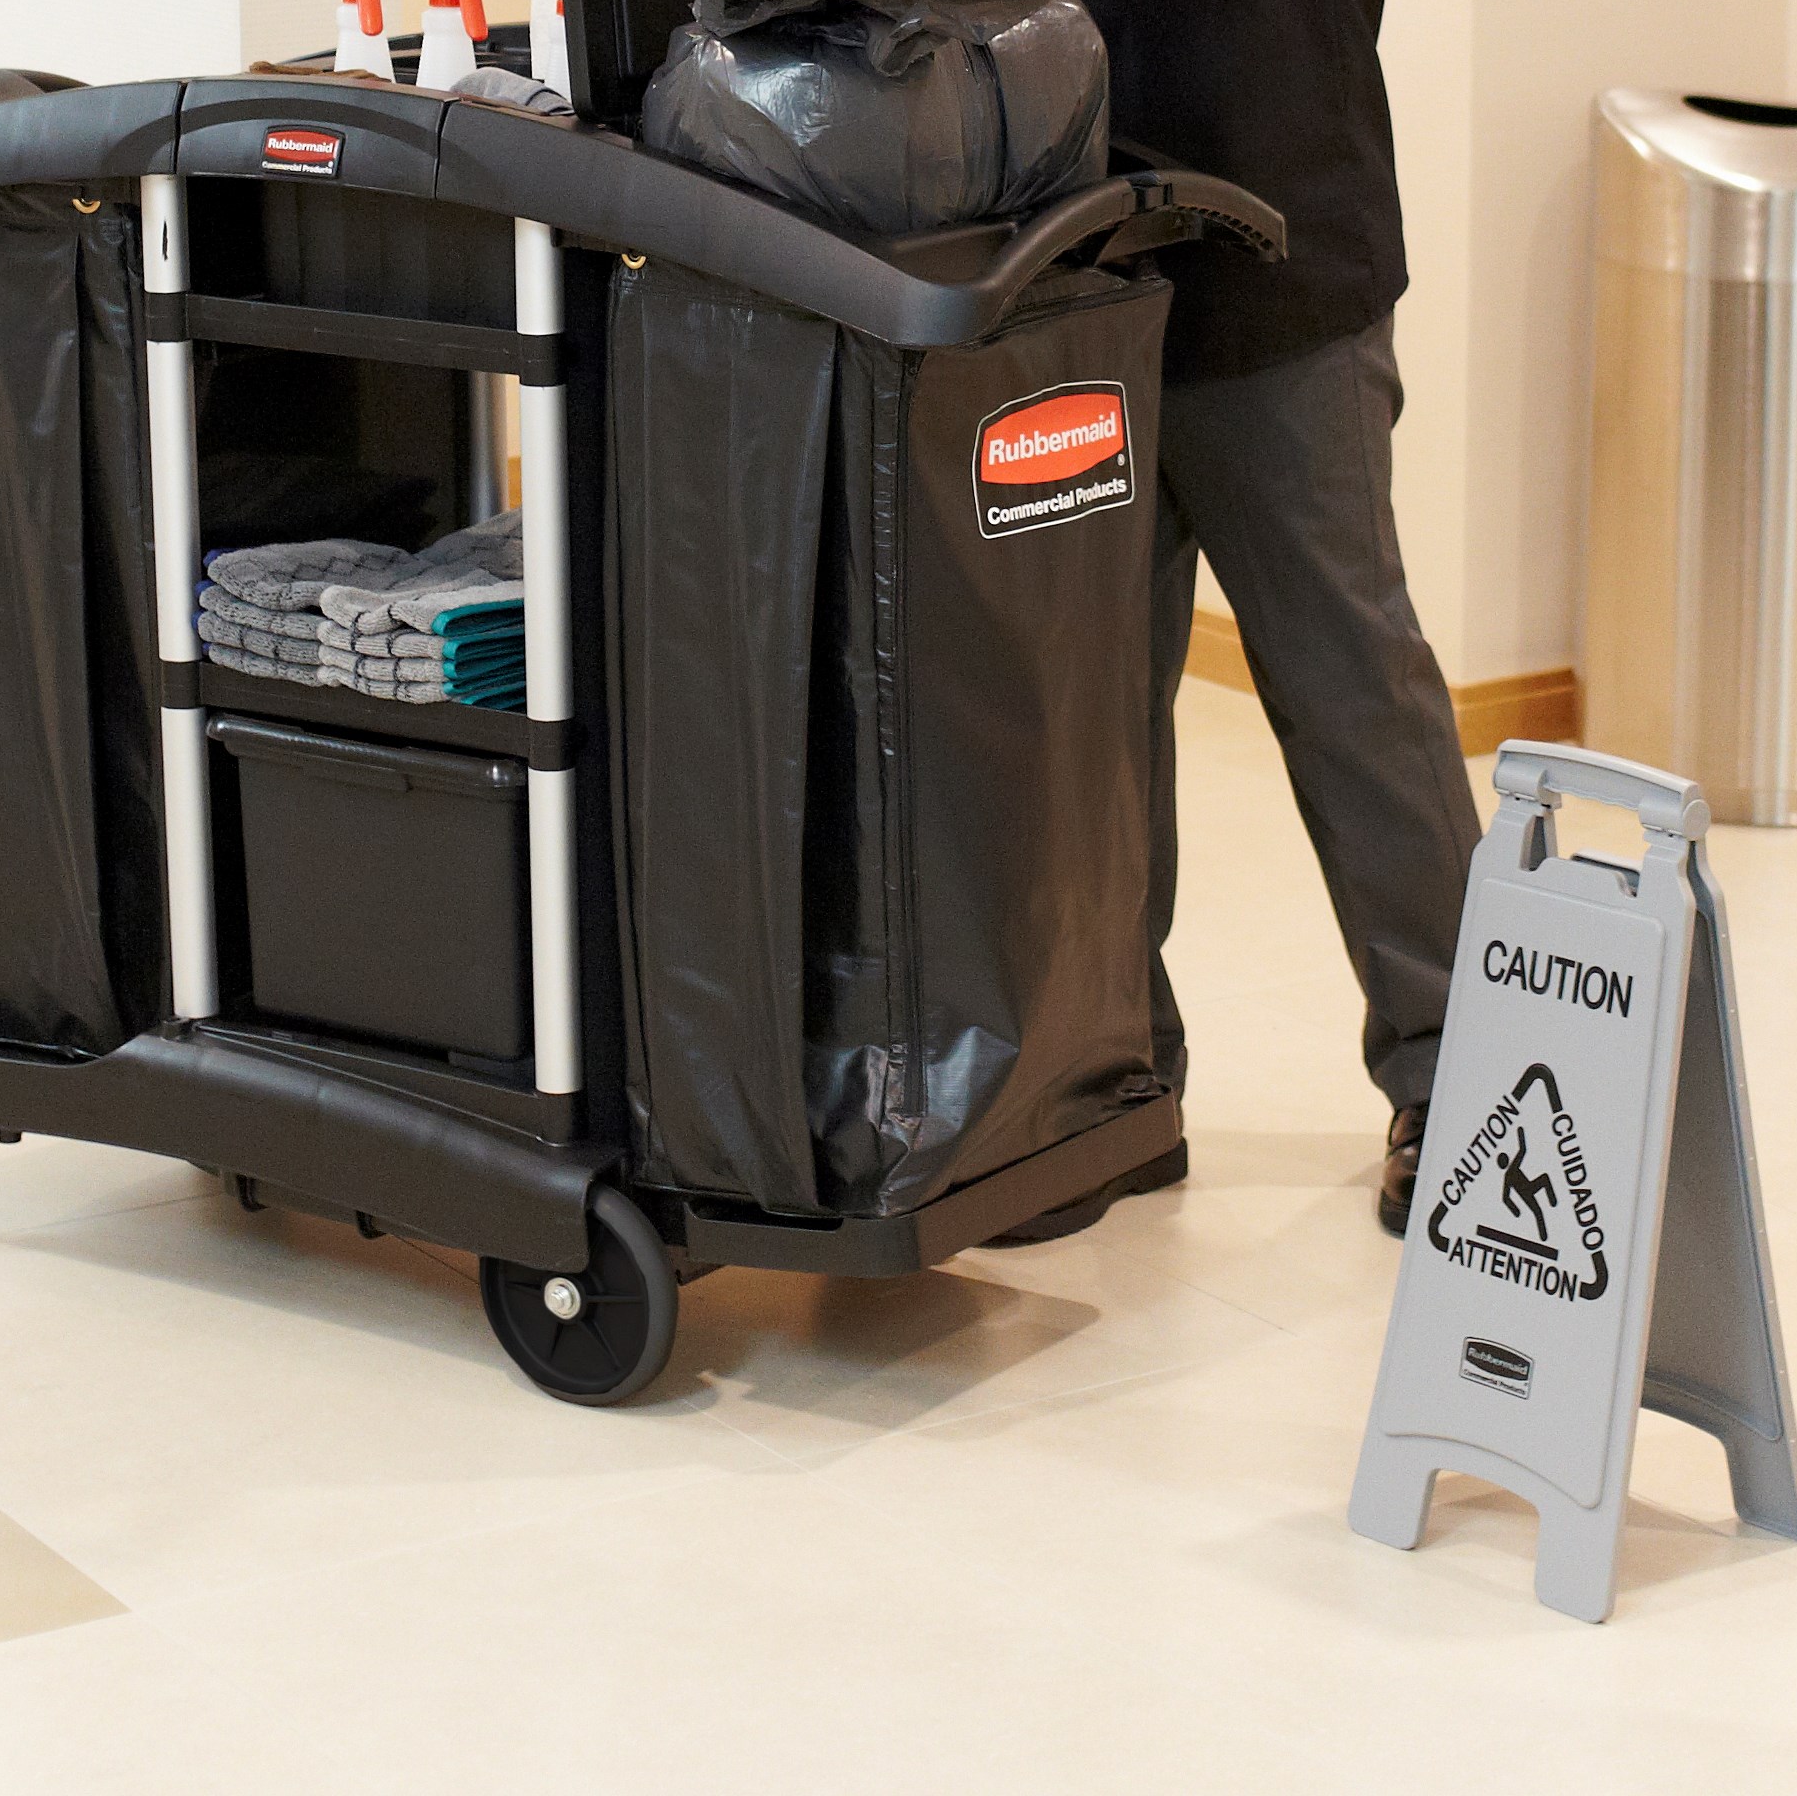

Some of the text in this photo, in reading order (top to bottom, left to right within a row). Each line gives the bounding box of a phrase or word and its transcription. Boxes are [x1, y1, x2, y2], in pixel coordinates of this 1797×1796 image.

[267, 137, 333, 153] Rubbermaid
[988, 411, 1117, 466] Rubbermaid
[987, 477, 1128, 526] Commercial Products
[1483, 939, 1634, 1019] CAUTION
[1442, 1094, 1521, 1206] CAUTION
[1551, 1113, 1604, 1251] CUIDADO
[1448, 1236, 1578, 1302] ATTENTION
